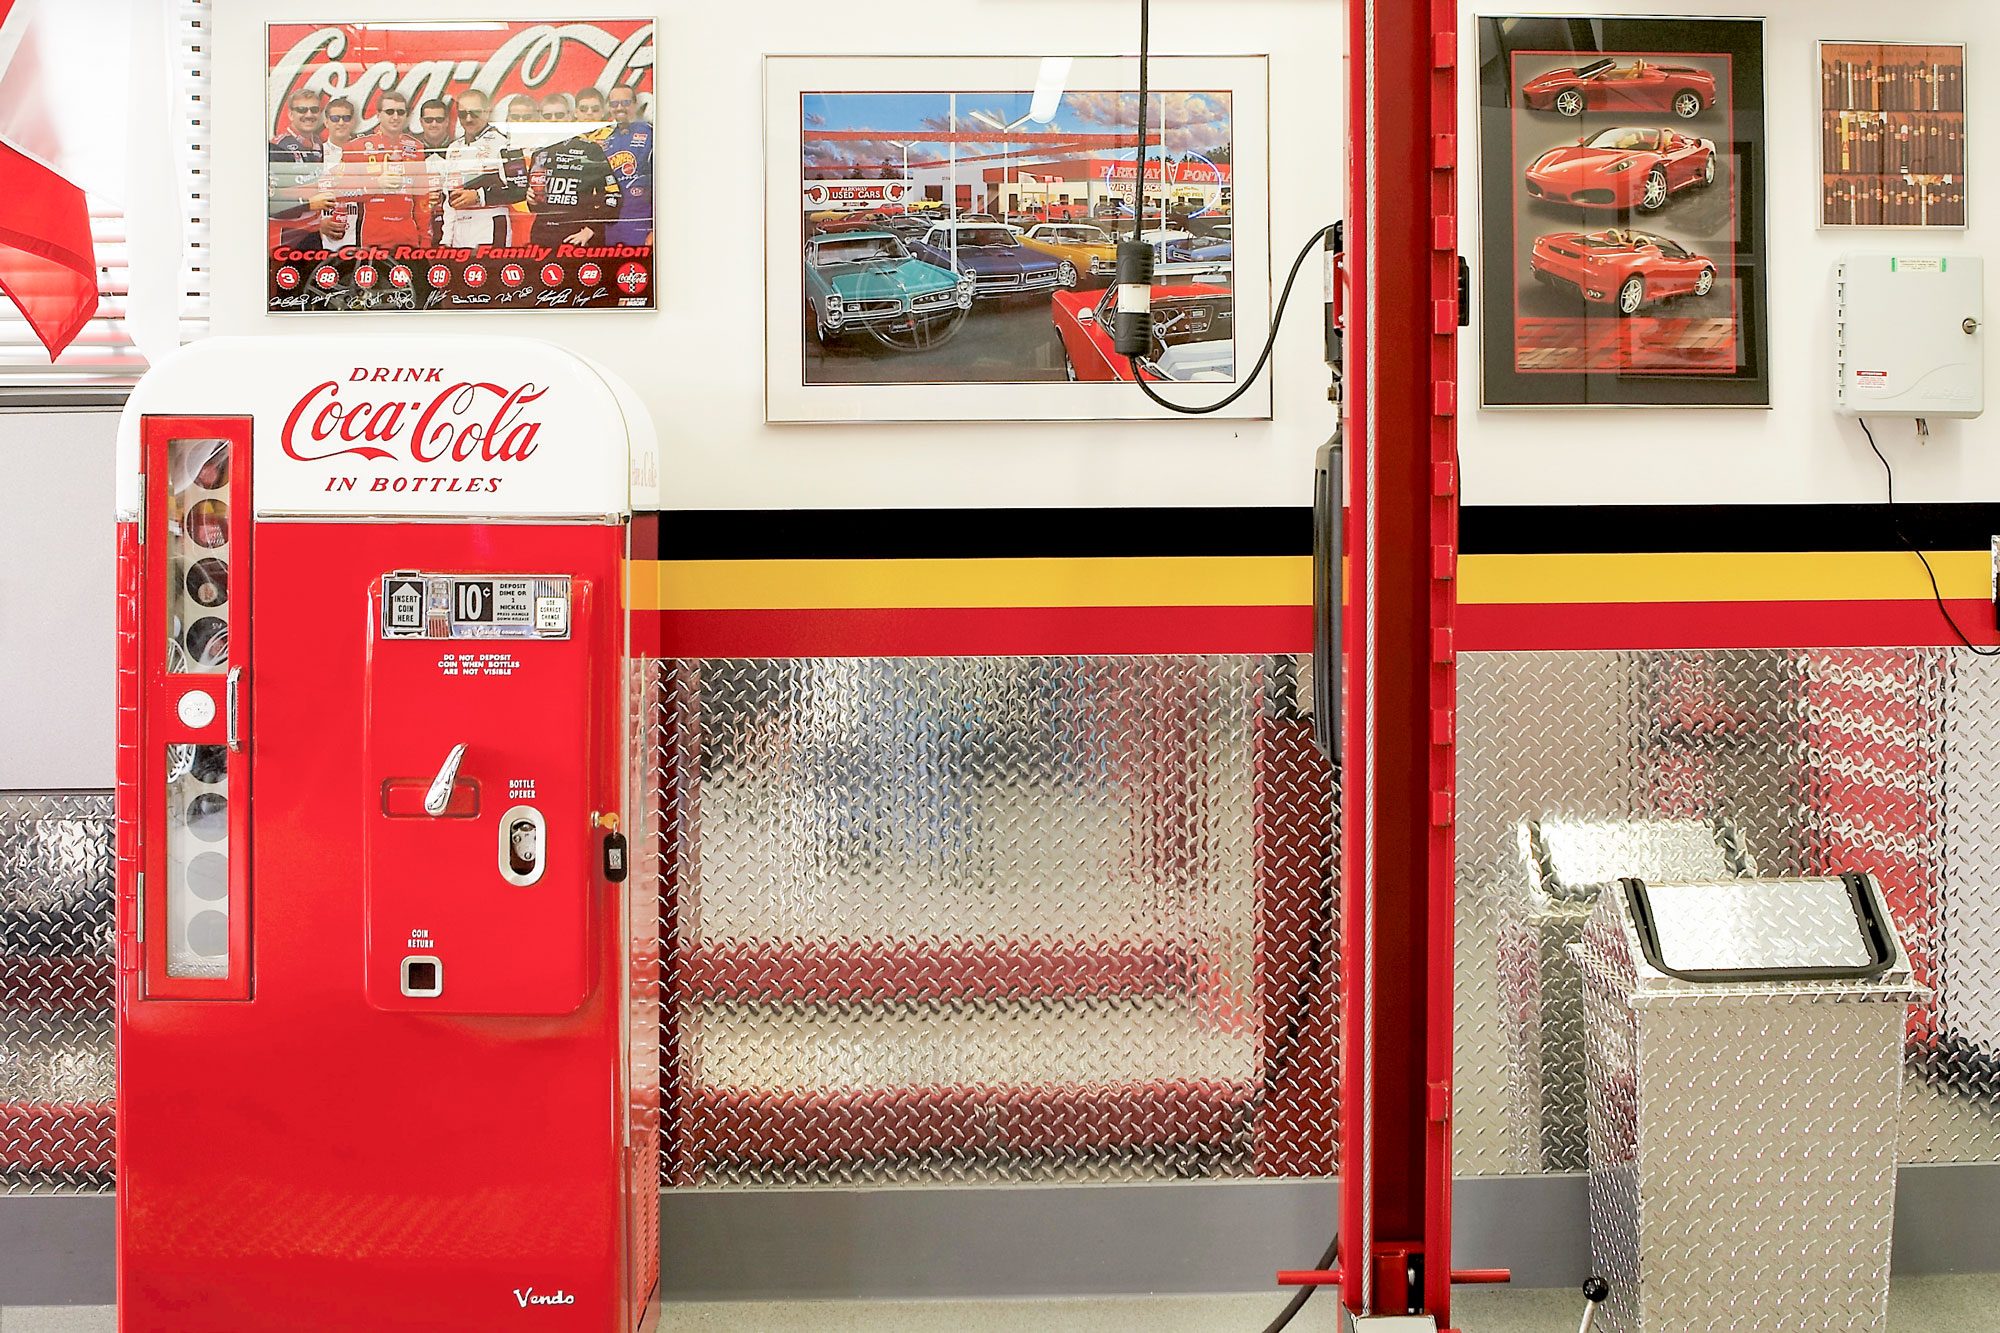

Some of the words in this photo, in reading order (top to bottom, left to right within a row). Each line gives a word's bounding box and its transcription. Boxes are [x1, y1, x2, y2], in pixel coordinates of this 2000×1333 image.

[832, 191, 854, 199] USED
[858, 191, 881, 199] CARS
[273, 246, 390, 262] Coca-Cola
[394, 246, 471, 263] Racing
[475, 243, 552, 262] Family
[556, 243, 650, 259] Reunion
[281, 273, 296, 284] 3
[319, 272, 336, 284] 88
[432, 270, 447, 283] 99
[467, 270, 483, 282] 94
[505, 269, 521, 281] 10
[547, 269, 559, 281] 1
[580, 269, 599, 280] 28
[348, 367, 444, 383] DRINK
[281, 380, 550, 463] Coca-Cola
[325, 477, 358, 492] IN
[370, 477, 503, 493] BOTTLES
[394, 595, 418, 603] INSERT
[398, 604, 414, 613] COIN
[397, 614, 415, 623] HERE
[438, 660, 458, 668] COIN
[462, 660, 484, 668] WHEN
[488, 660, 520, 668] BOTTLES
[509, 779, 535, 789] BOTTLE
[509, 790, 536, 799] OPENER
[411, 929, 429, 938] COIN
[407, 939, 434, 948] RETURN
[513, 1286, 575, 1308] Vendo
